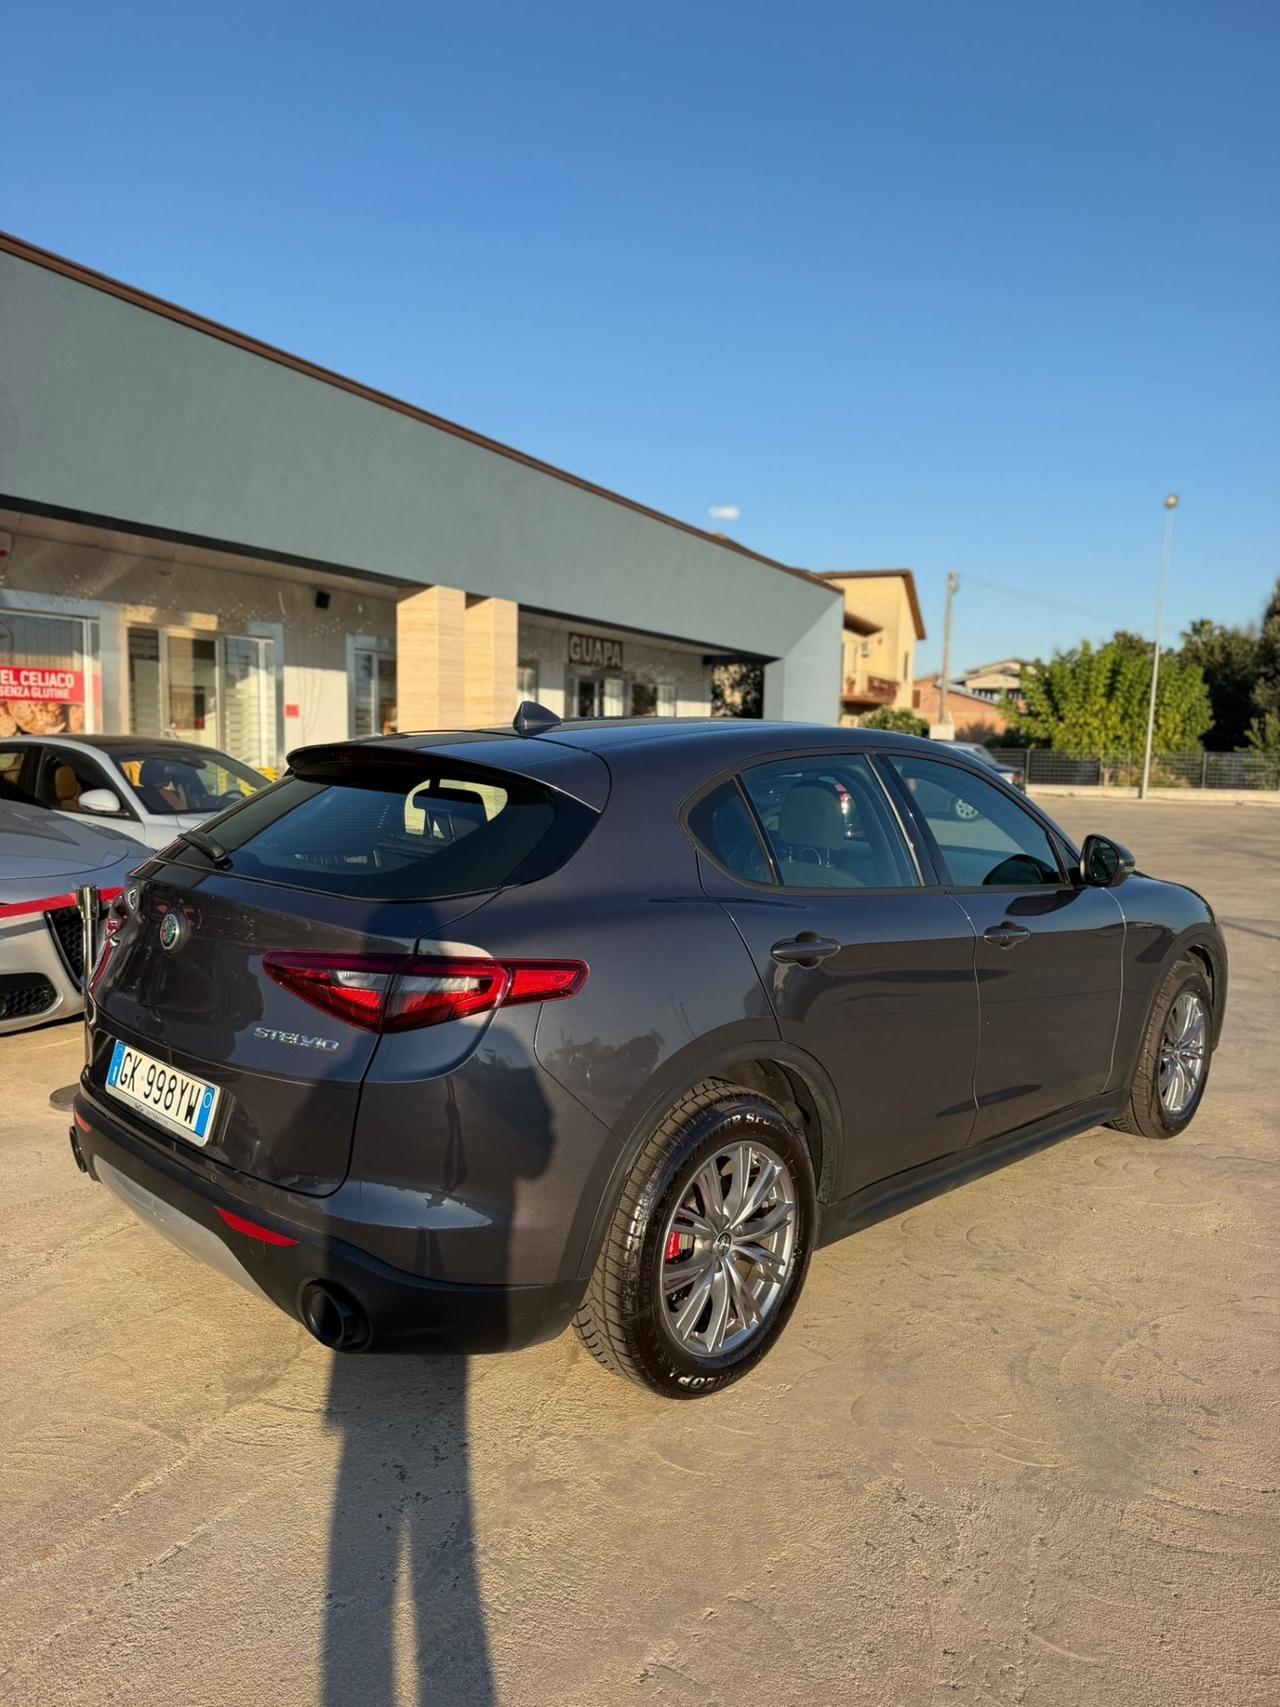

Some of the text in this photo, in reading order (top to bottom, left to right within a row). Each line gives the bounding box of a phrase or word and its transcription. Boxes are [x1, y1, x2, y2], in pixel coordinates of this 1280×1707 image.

[570, 635, 622, 667] GUAPA
[20, 671, 75, 688] CELIACO
[0, 685, 70, 699] SENZA GLUTINE
[253, 1027, 340, 1052] STELVIO
